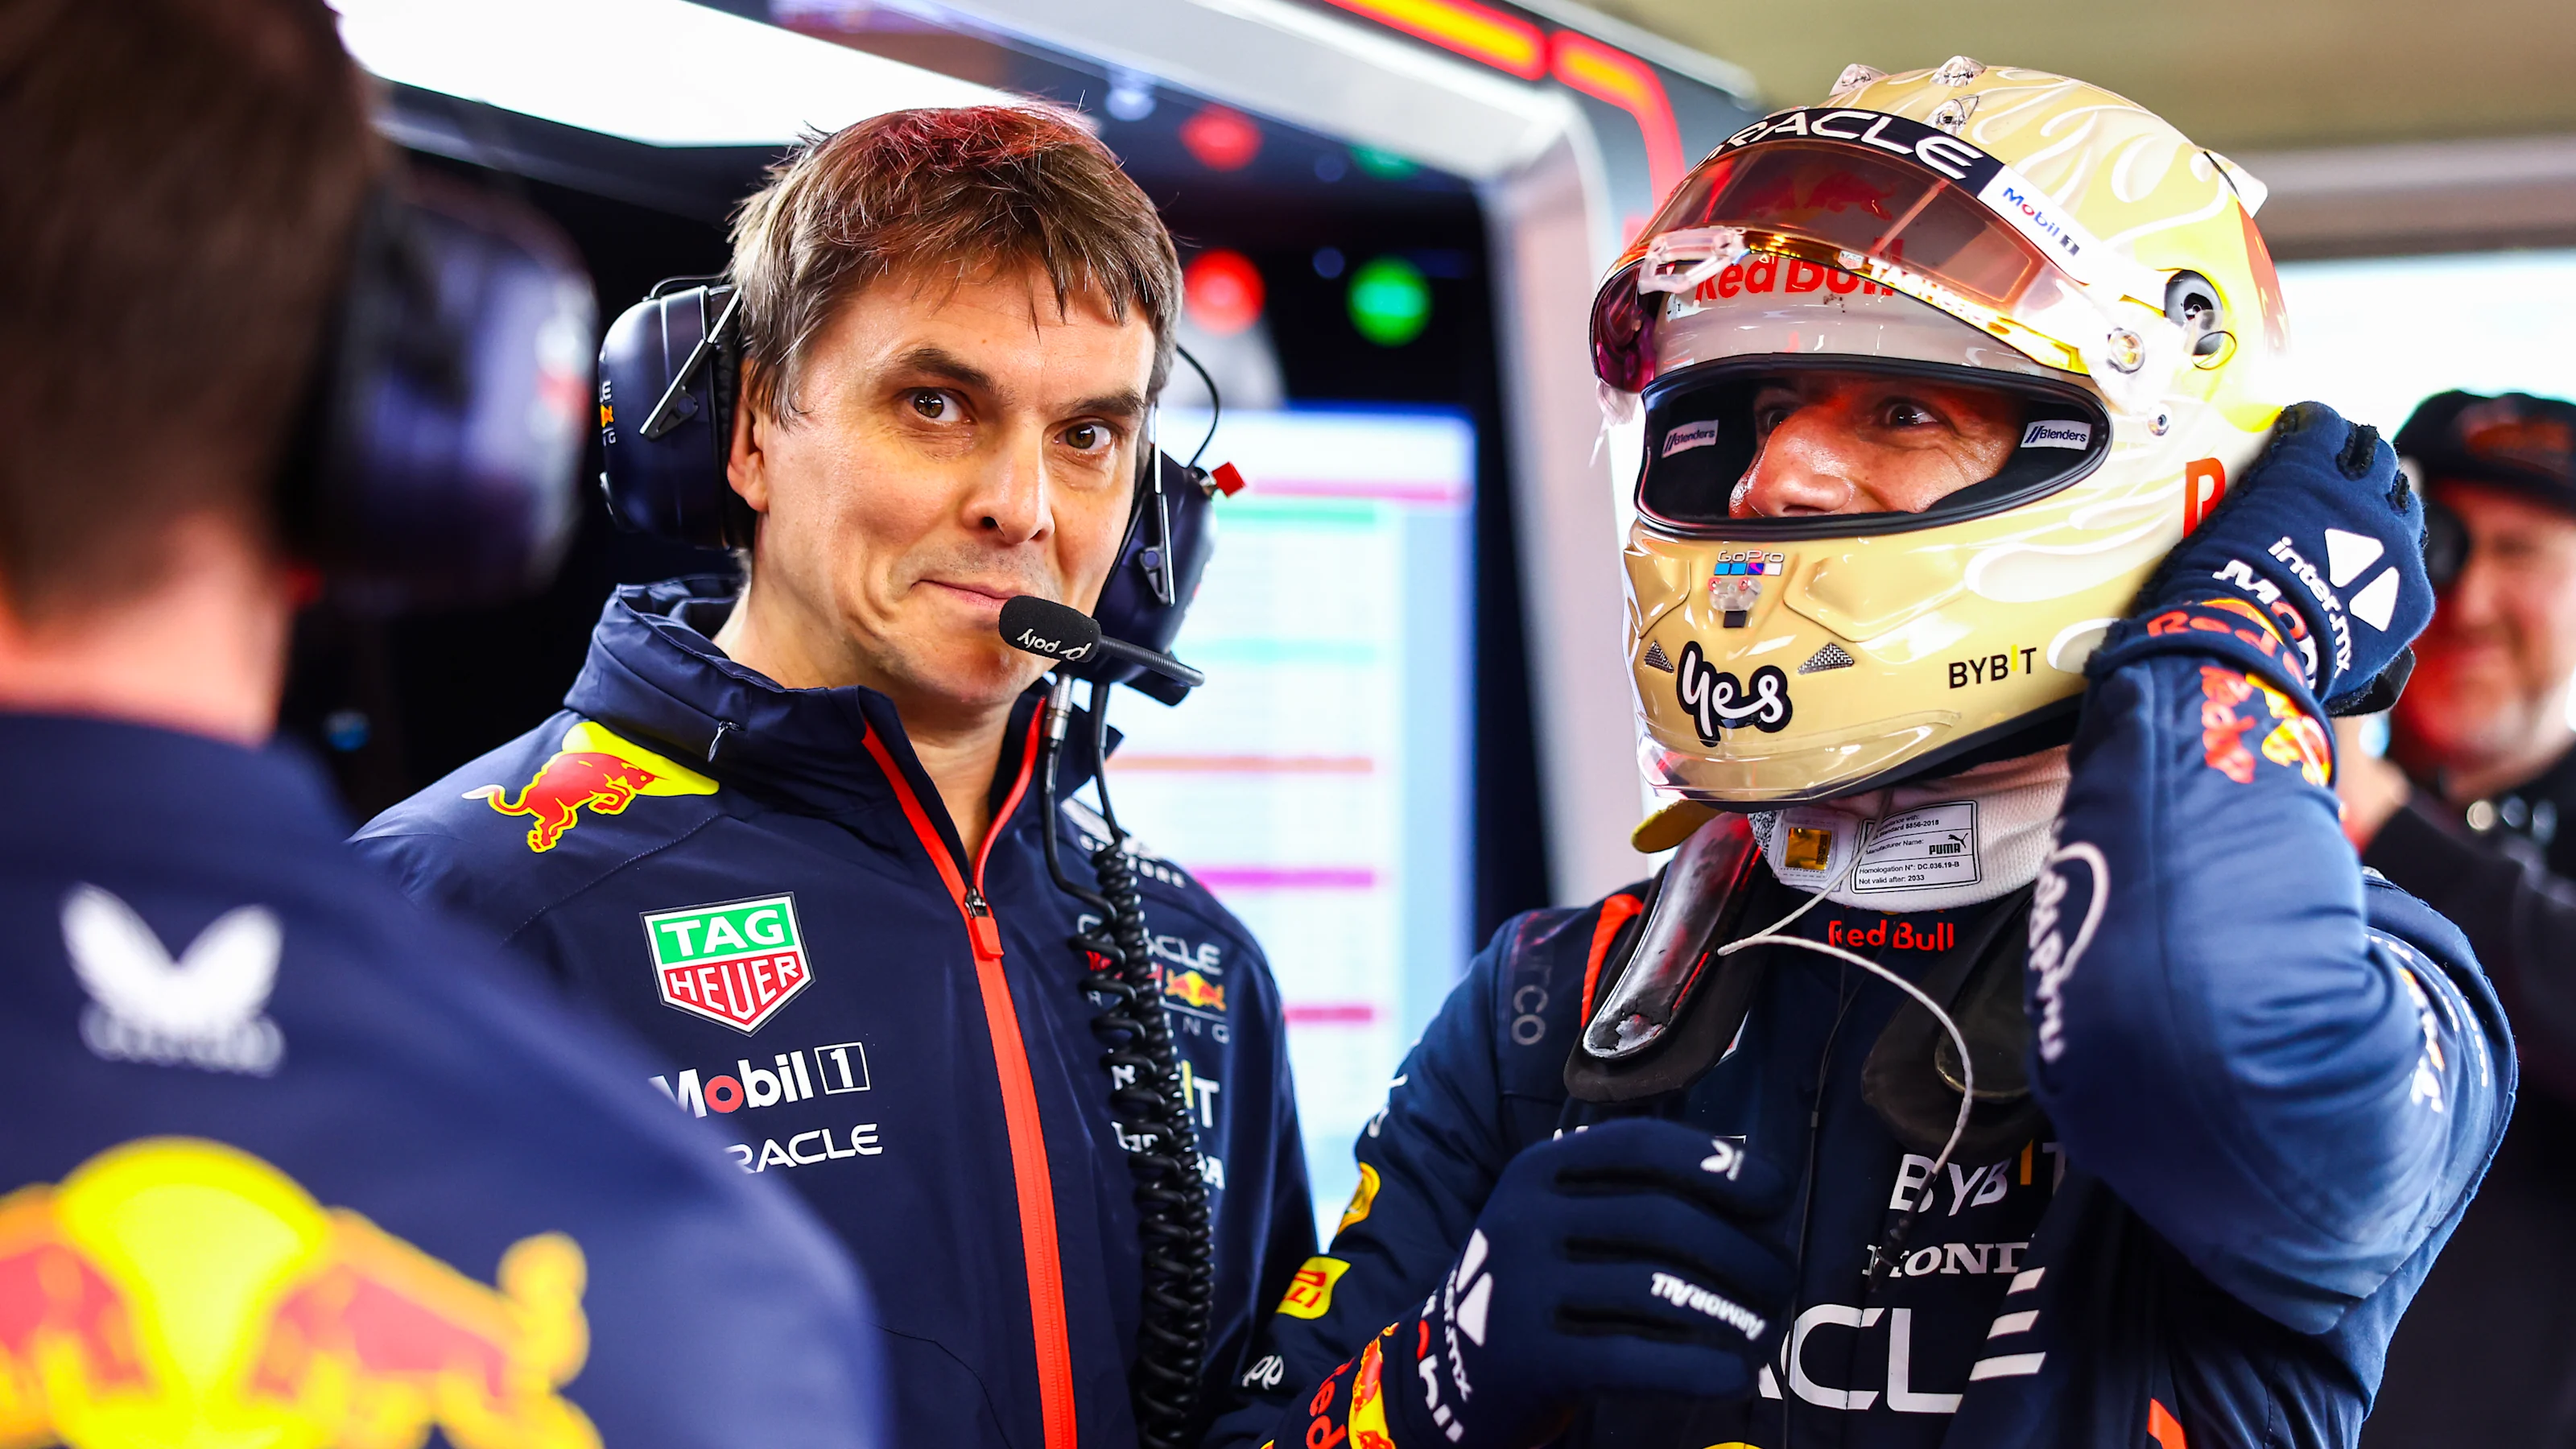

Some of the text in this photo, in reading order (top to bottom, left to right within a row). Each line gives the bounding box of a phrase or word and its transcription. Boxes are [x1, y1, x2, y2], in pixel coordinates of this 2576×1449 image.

[2001, 187, 2061, 237] Mobil
[2040, 428, 2087, 443] Blenders
[1716, 549, 1785, 563] GoPro
[2267, 535, 2351, 679] inter.mx
[1017, 628, 1062, 653] poly
[1948, 643, 2037, 690] BYBIT
[1859, 865, 1904, 874] Homologation
[1929, 843, 1961, 855] PUMA
[659, 909, 786, 957] TAG
[1828, 919, 1955, 952] Red Bull
[668, 956, 799, 1021] HEUER
[648, 1051, 814, 1118] Mobil
[722, 1124, 883, 1175] RACLE
